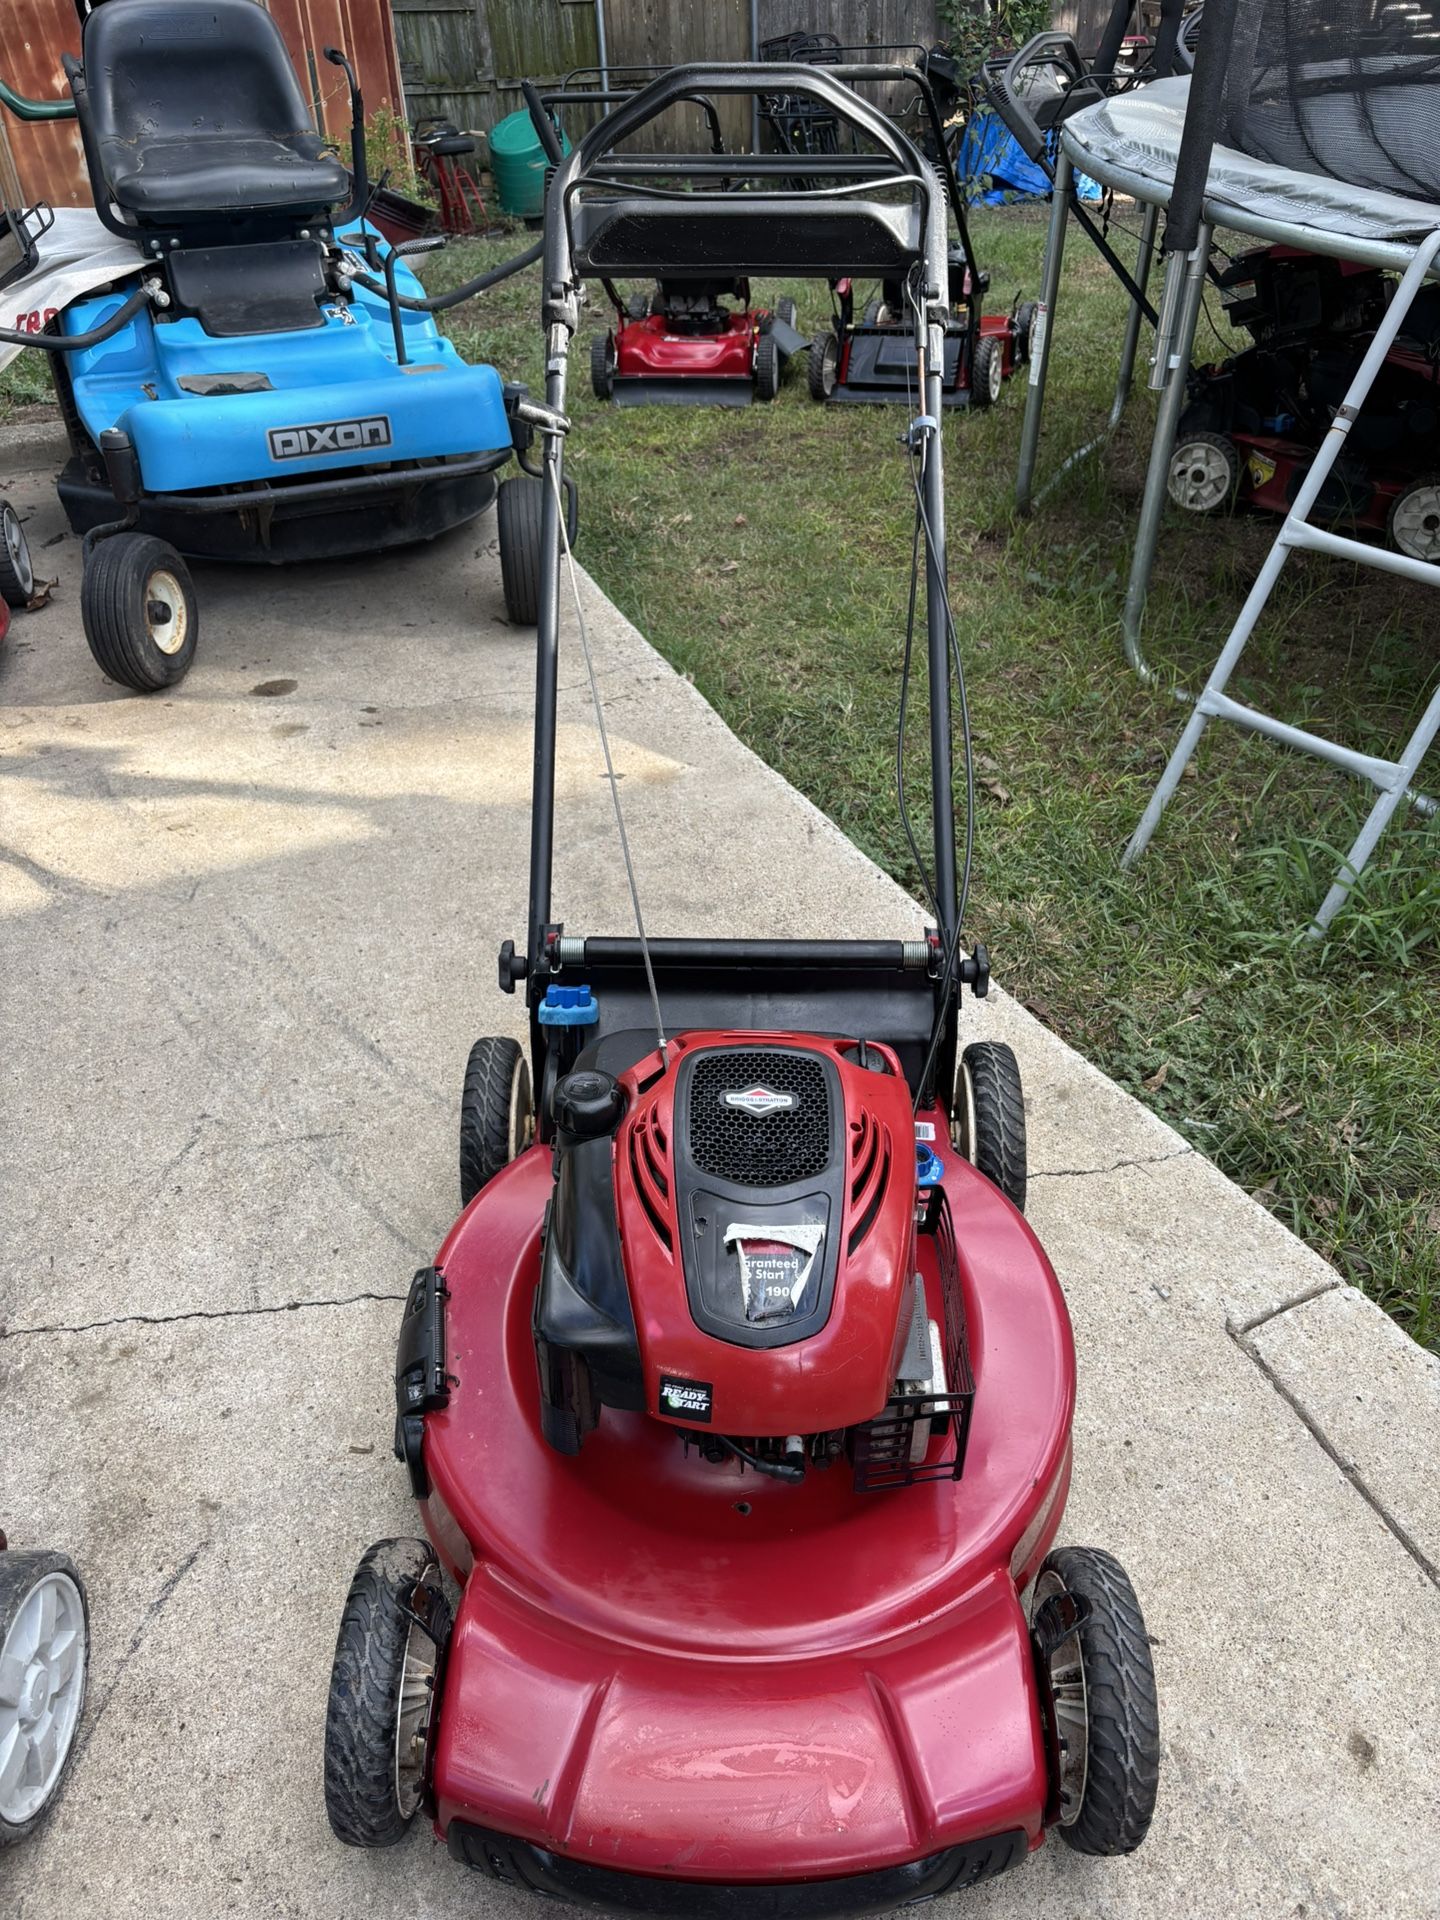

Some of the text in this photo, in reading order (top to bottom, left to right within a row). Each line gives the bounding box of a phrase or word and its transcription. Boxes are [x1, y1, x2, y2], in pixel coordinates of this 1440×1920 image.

[272, 420, 388, 456] DIXON
[745, 1258, 798, 1269] aranteed
[755, 1269, 785, 1280] Start
[765, 1286, 790, 1297] 190
[661, 1387, 707, 1402] READY
[671, 1396, 710, 1411] START
